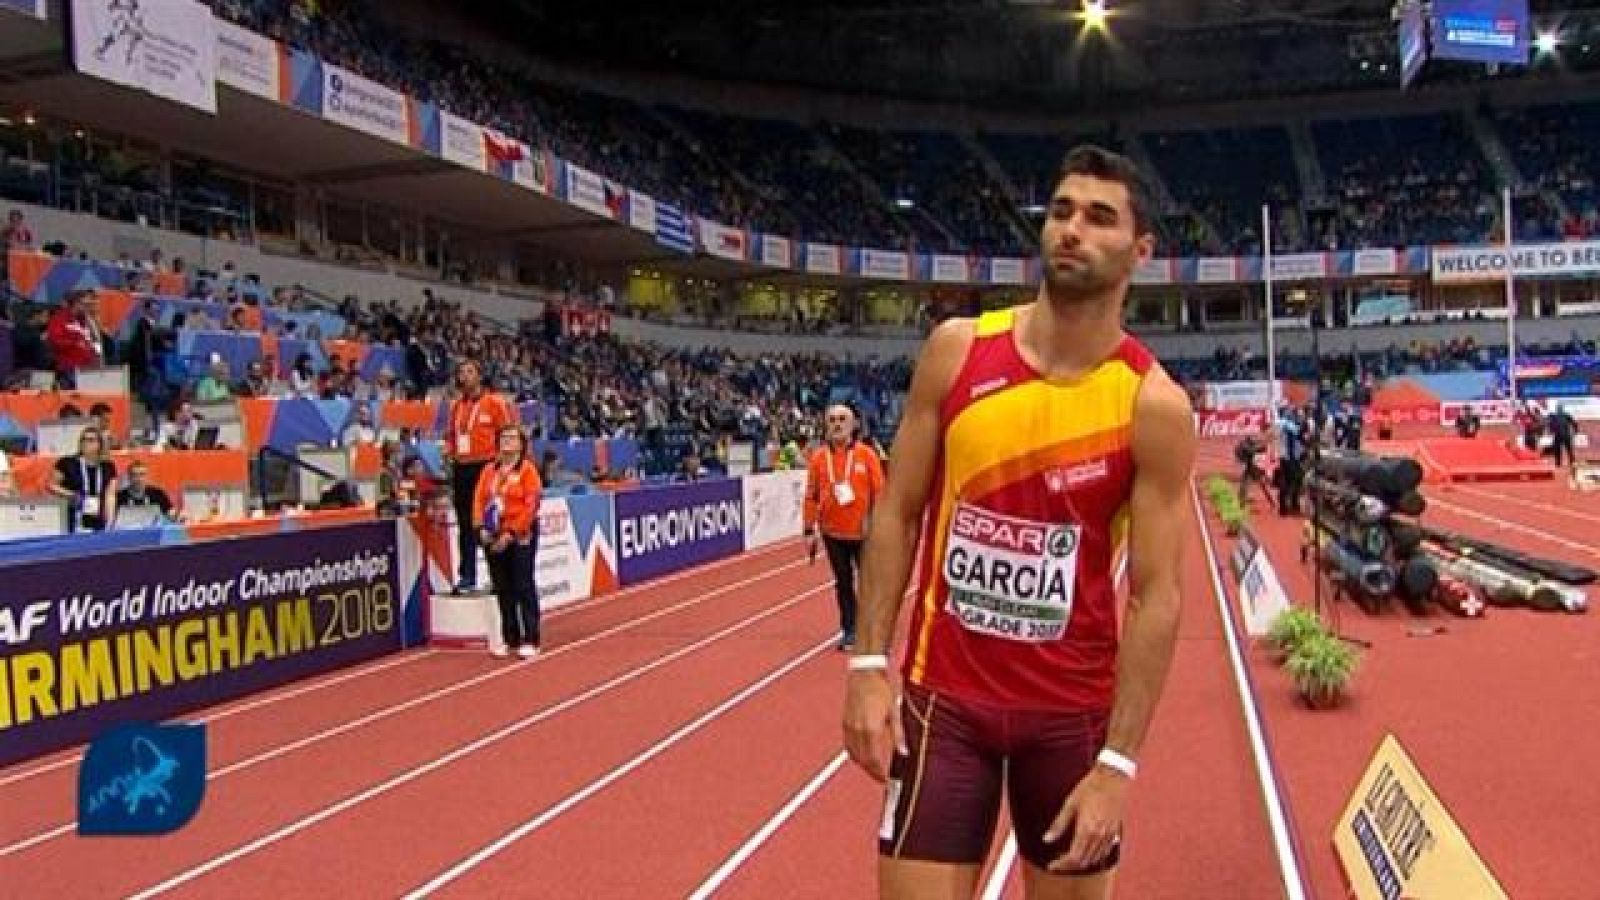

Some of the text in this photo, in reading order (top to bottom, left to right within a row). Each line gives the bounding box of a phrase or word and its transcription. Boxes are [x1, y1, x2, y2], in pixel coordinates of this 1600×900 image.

[1540, 250, 1566, 267] TO
[953, 509, 1043, 553] SPAR
[59, 584, 148, 636] World
[152, 578, 236, 617] Indoor
[239, 550, 389, 601] Championships
[948, 546, 1067, 601] GARCÍA
[317, 582, 393, 647] 2018
